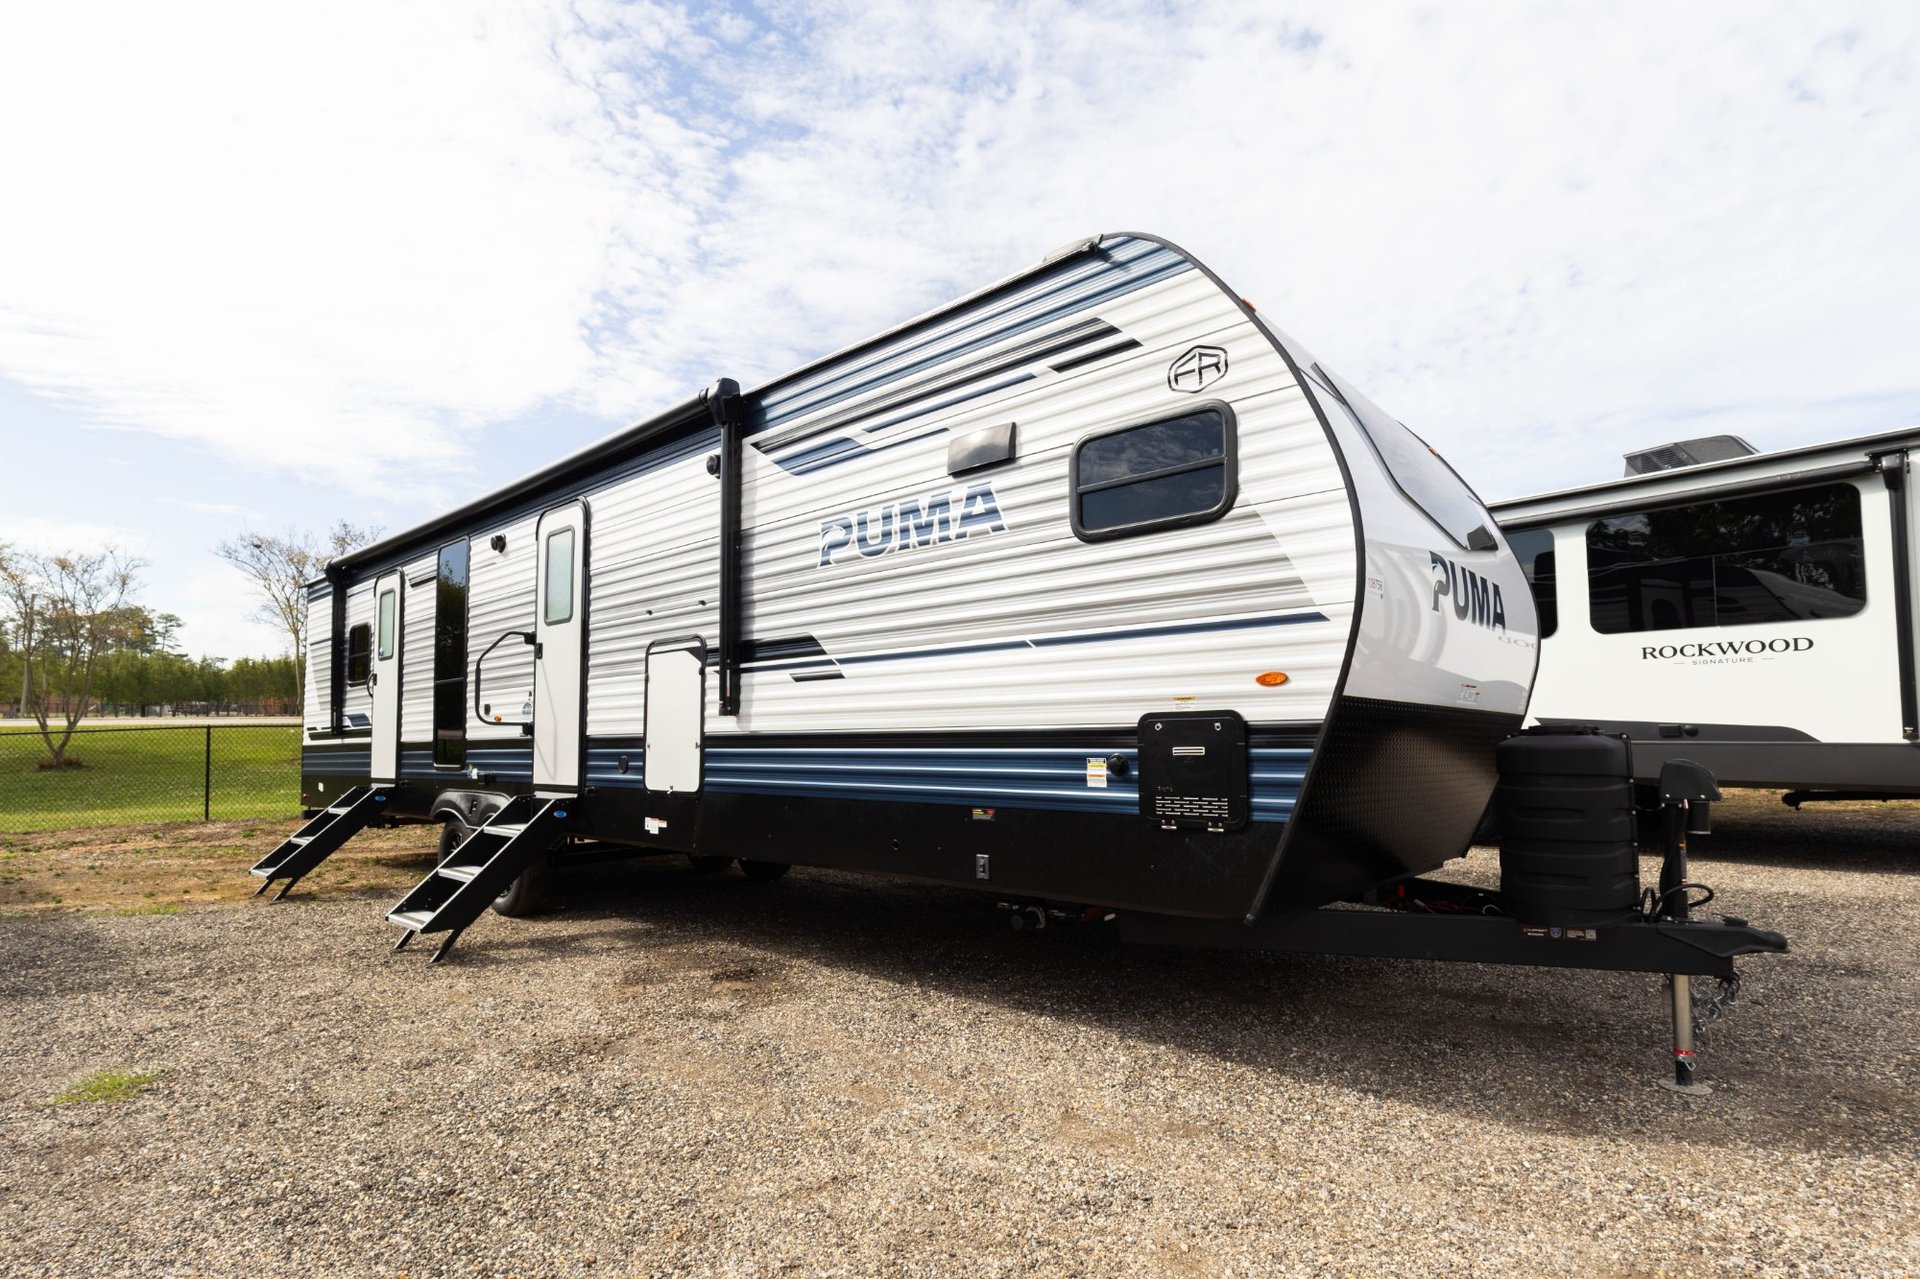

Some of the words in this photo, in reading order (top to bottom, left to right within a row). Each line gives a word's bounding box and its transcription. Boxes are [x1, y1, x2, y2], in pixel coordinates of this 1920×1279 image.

[818, 480, 1008, 568] PUMA
[1428, 549, 1507, 636] PUMA
[1641, 637, 1815, 660] ROCKWOOD
[1691, 656, 1755, 666] SIGNATURE
